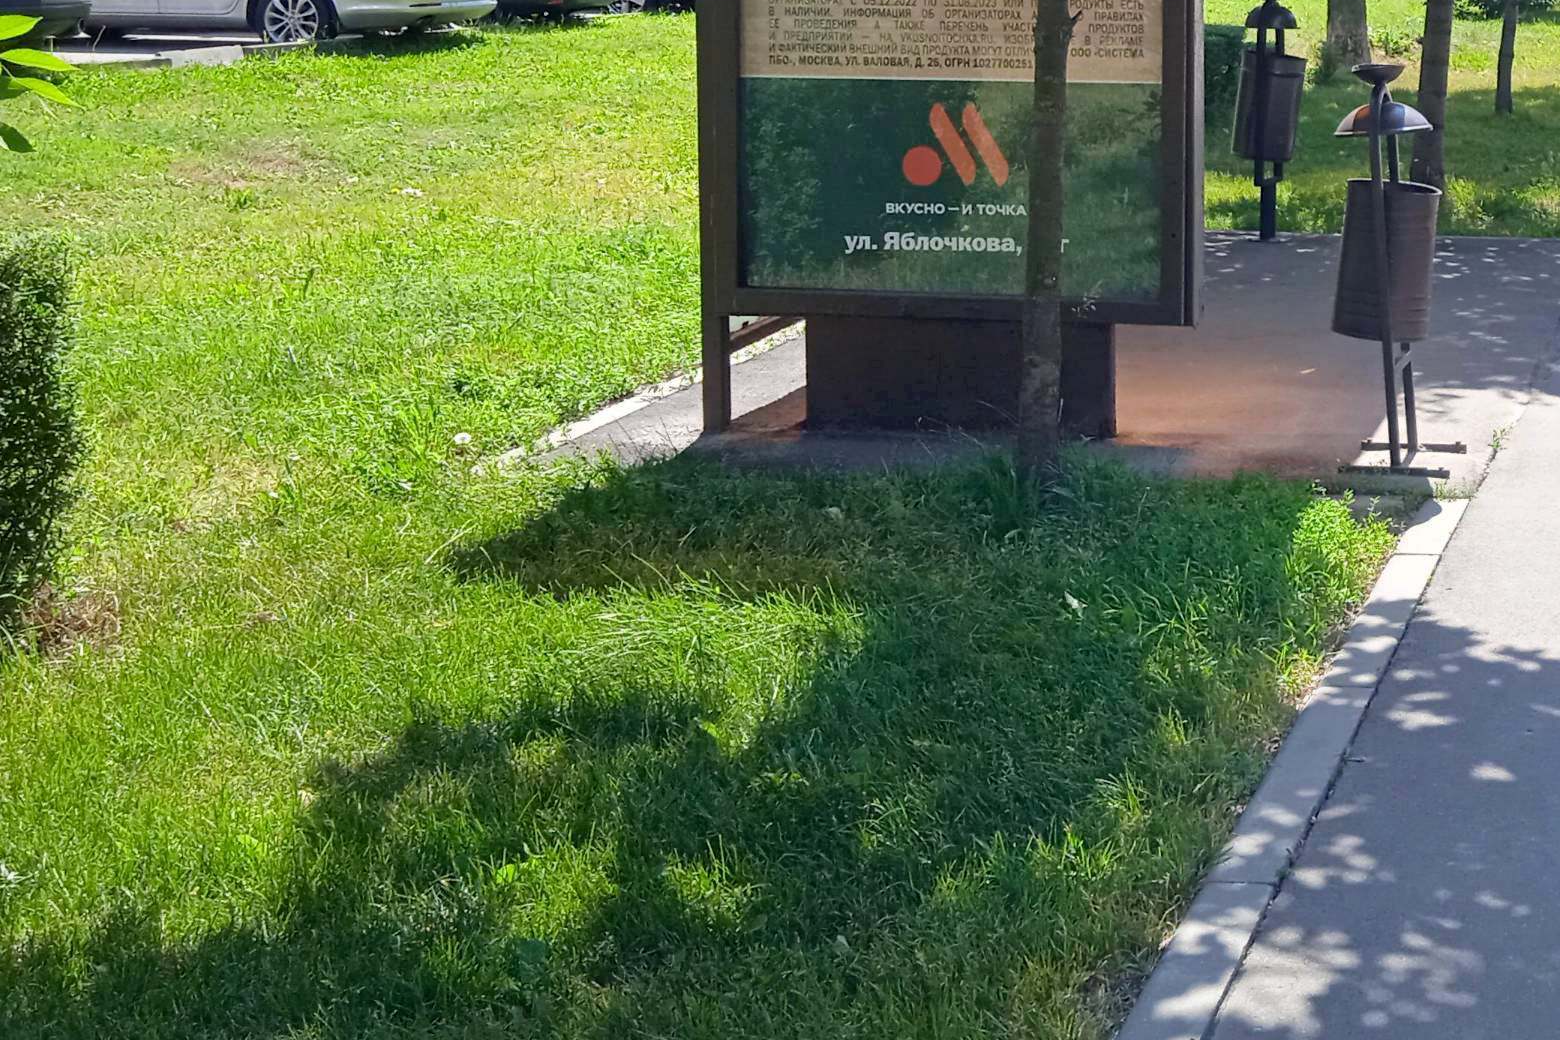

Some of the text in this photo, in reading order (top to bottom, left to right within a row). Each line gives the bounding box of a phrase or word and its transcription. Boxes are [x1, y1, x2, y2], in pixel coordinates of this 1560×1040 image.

[1069, 0, 1114, 10] РОДУКТЫ
[1120, 0, 1144, 10] ЕСТЬ
[768, 6, 775, 16] В
[843, 7, 912, 19] ИНФОРМАЦИЯ
[921, 8, 935, 19] ОБ
[944, 8, 1021, 20] ОРГАНИЗАТОРАХ
[1094, 11, 1144, 21] ПРАВИЛАХ
[769, 18, 780, 29] ЕЕ
[940, 20, 989, 32] ПЕРЕЧЕНЬ
[1088, 23, 1144, 34] ПРОДУКТОВ
[1070, 48, 1091, 58] ООО
[944, 58, 970, 68] ОГРН
[973, 58, 1033, 69] 1027700251
[886, 203, 945, 215] ВКУСНО
[961, 204, 972, 215] И
[976, 205, 1027, 216] ТОЧКА
[845, 232, 1022, 256] ул. Яблочкова,
